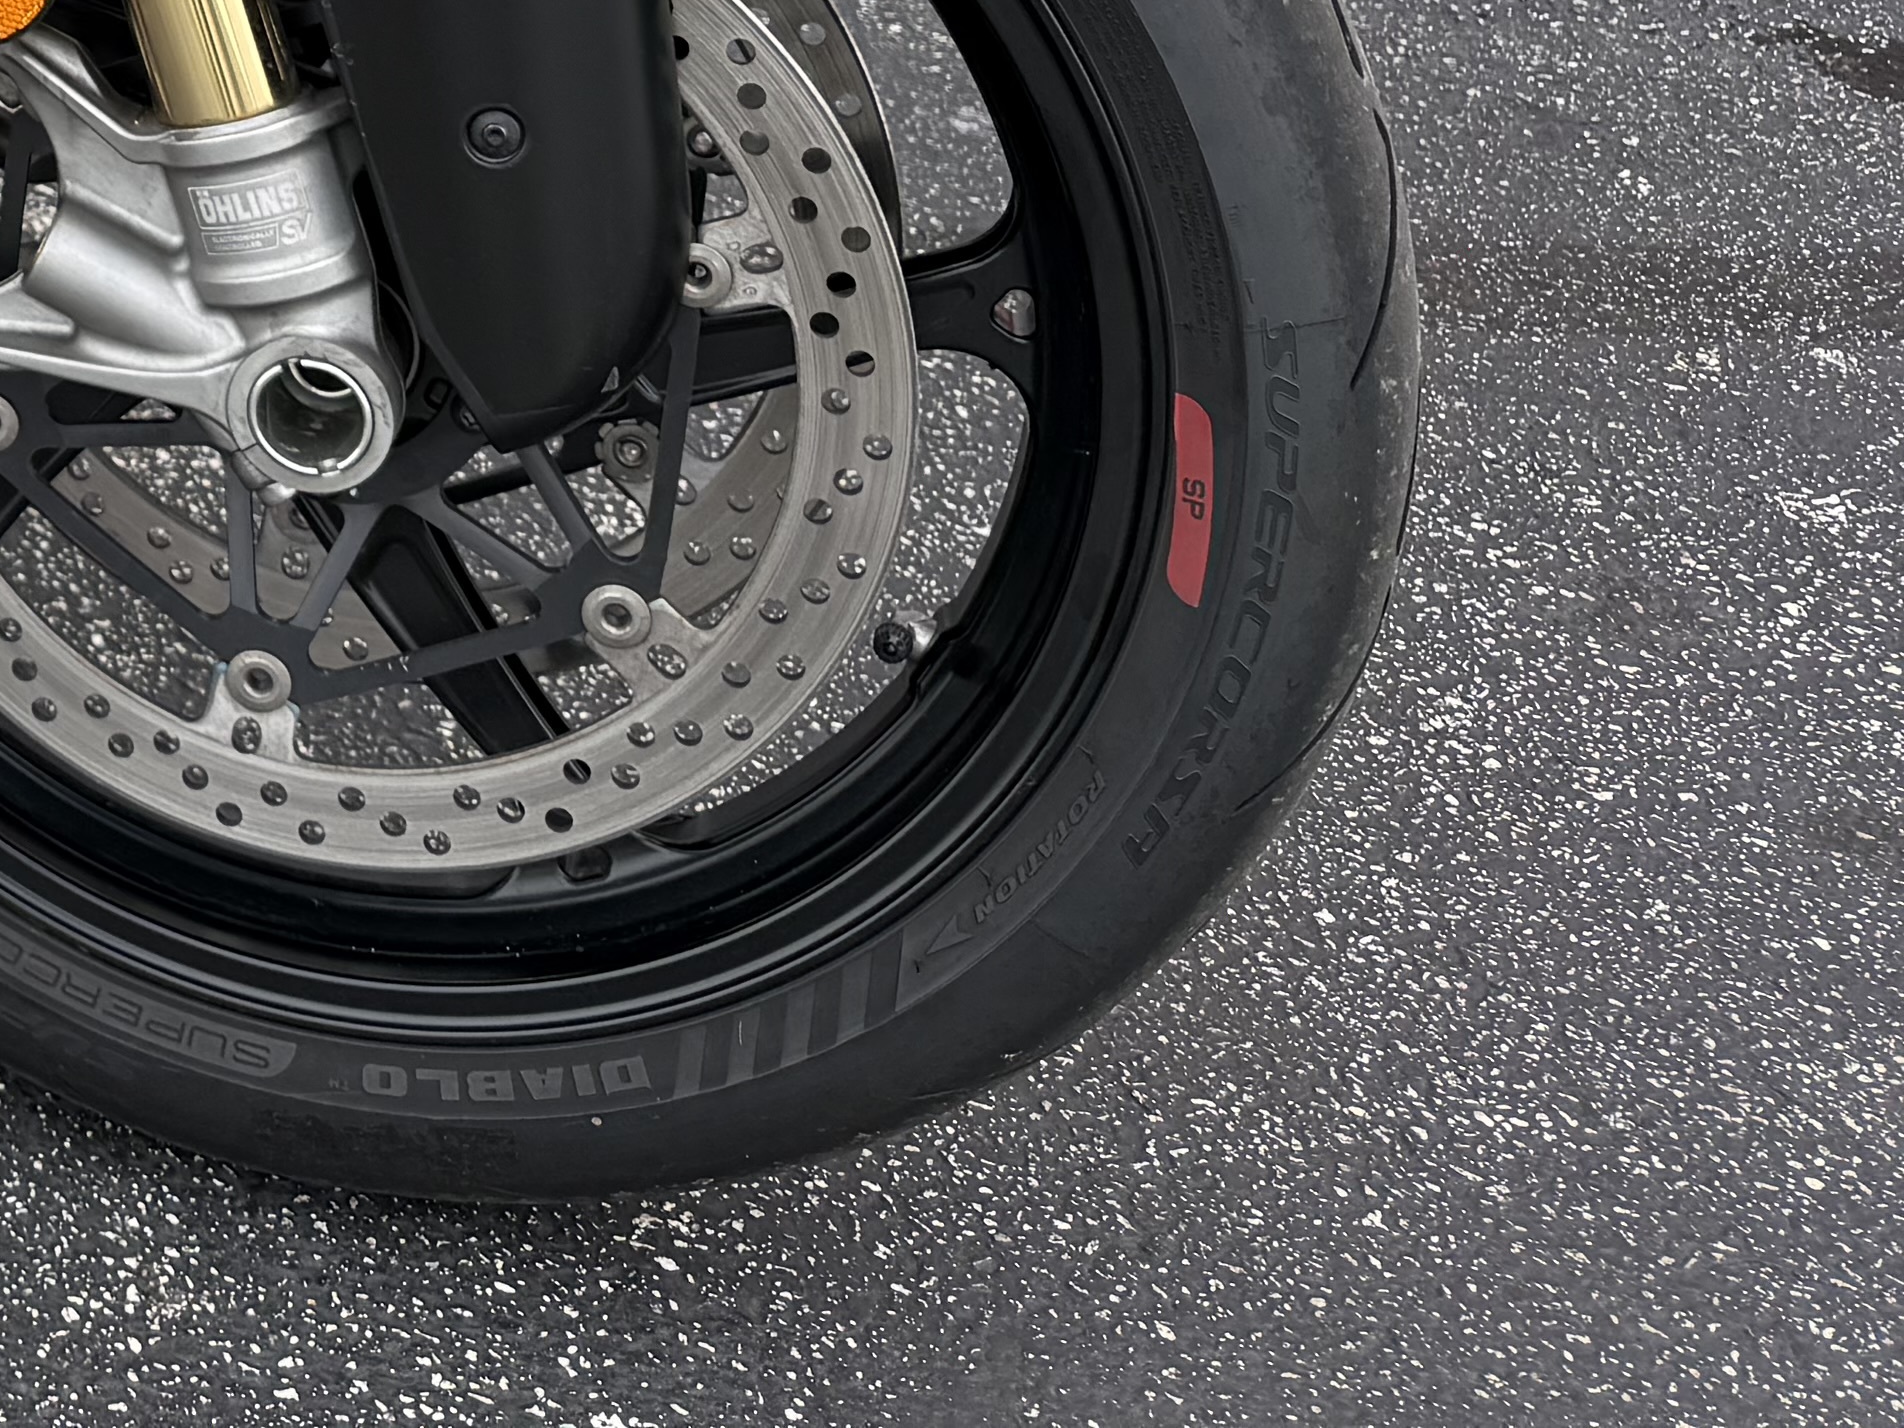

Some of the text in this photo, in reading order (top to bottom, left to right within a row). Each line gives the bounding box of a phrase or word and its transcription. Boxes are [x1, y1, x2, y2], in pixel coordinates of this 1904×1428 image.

[196, 181, 298, 224] ÖHLINS
[1182, 476, 1205, 521] SP
[1120, 314, 1301, 871] SUPERCORSA
[972, 768, 1109, 926] ROTATION
[361, 1054, 655, 1102] DIABLO
